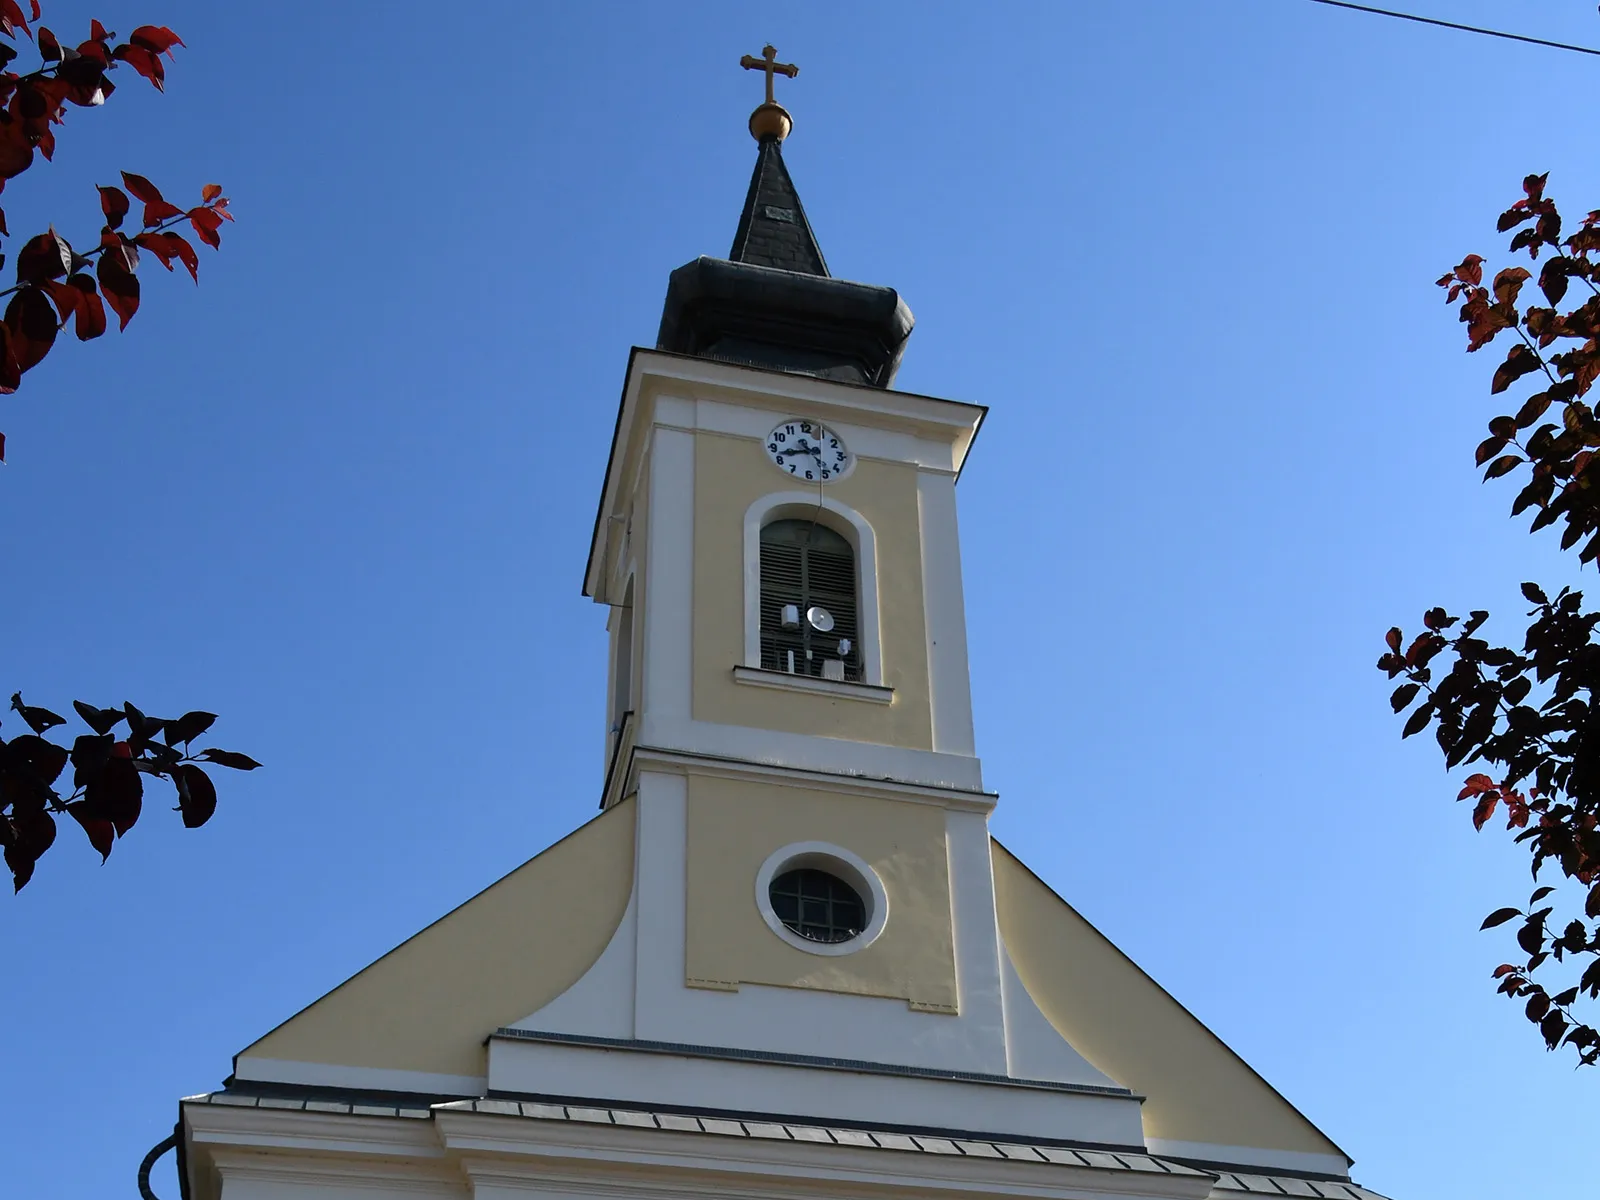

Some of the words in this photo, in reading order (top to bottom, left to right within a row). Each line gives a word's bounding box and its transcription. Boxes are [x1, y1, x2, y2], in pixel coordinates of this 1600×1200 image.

[786, 426, 794, 435] 11
[800, 424, 811, 434] 12
[774, 432, 785, 442] 10
[770, 443, 777, 452] 9
[830, 439, 838, 448] 2
[776, 456, 784, 465] 8
[837, 452, 844, 461] 3
[789, 465, 796, 473] 7
[833, 464, 840, 473] 4
[805, 471, 813, 479] 6
[822, 470, 830, 479] 5
